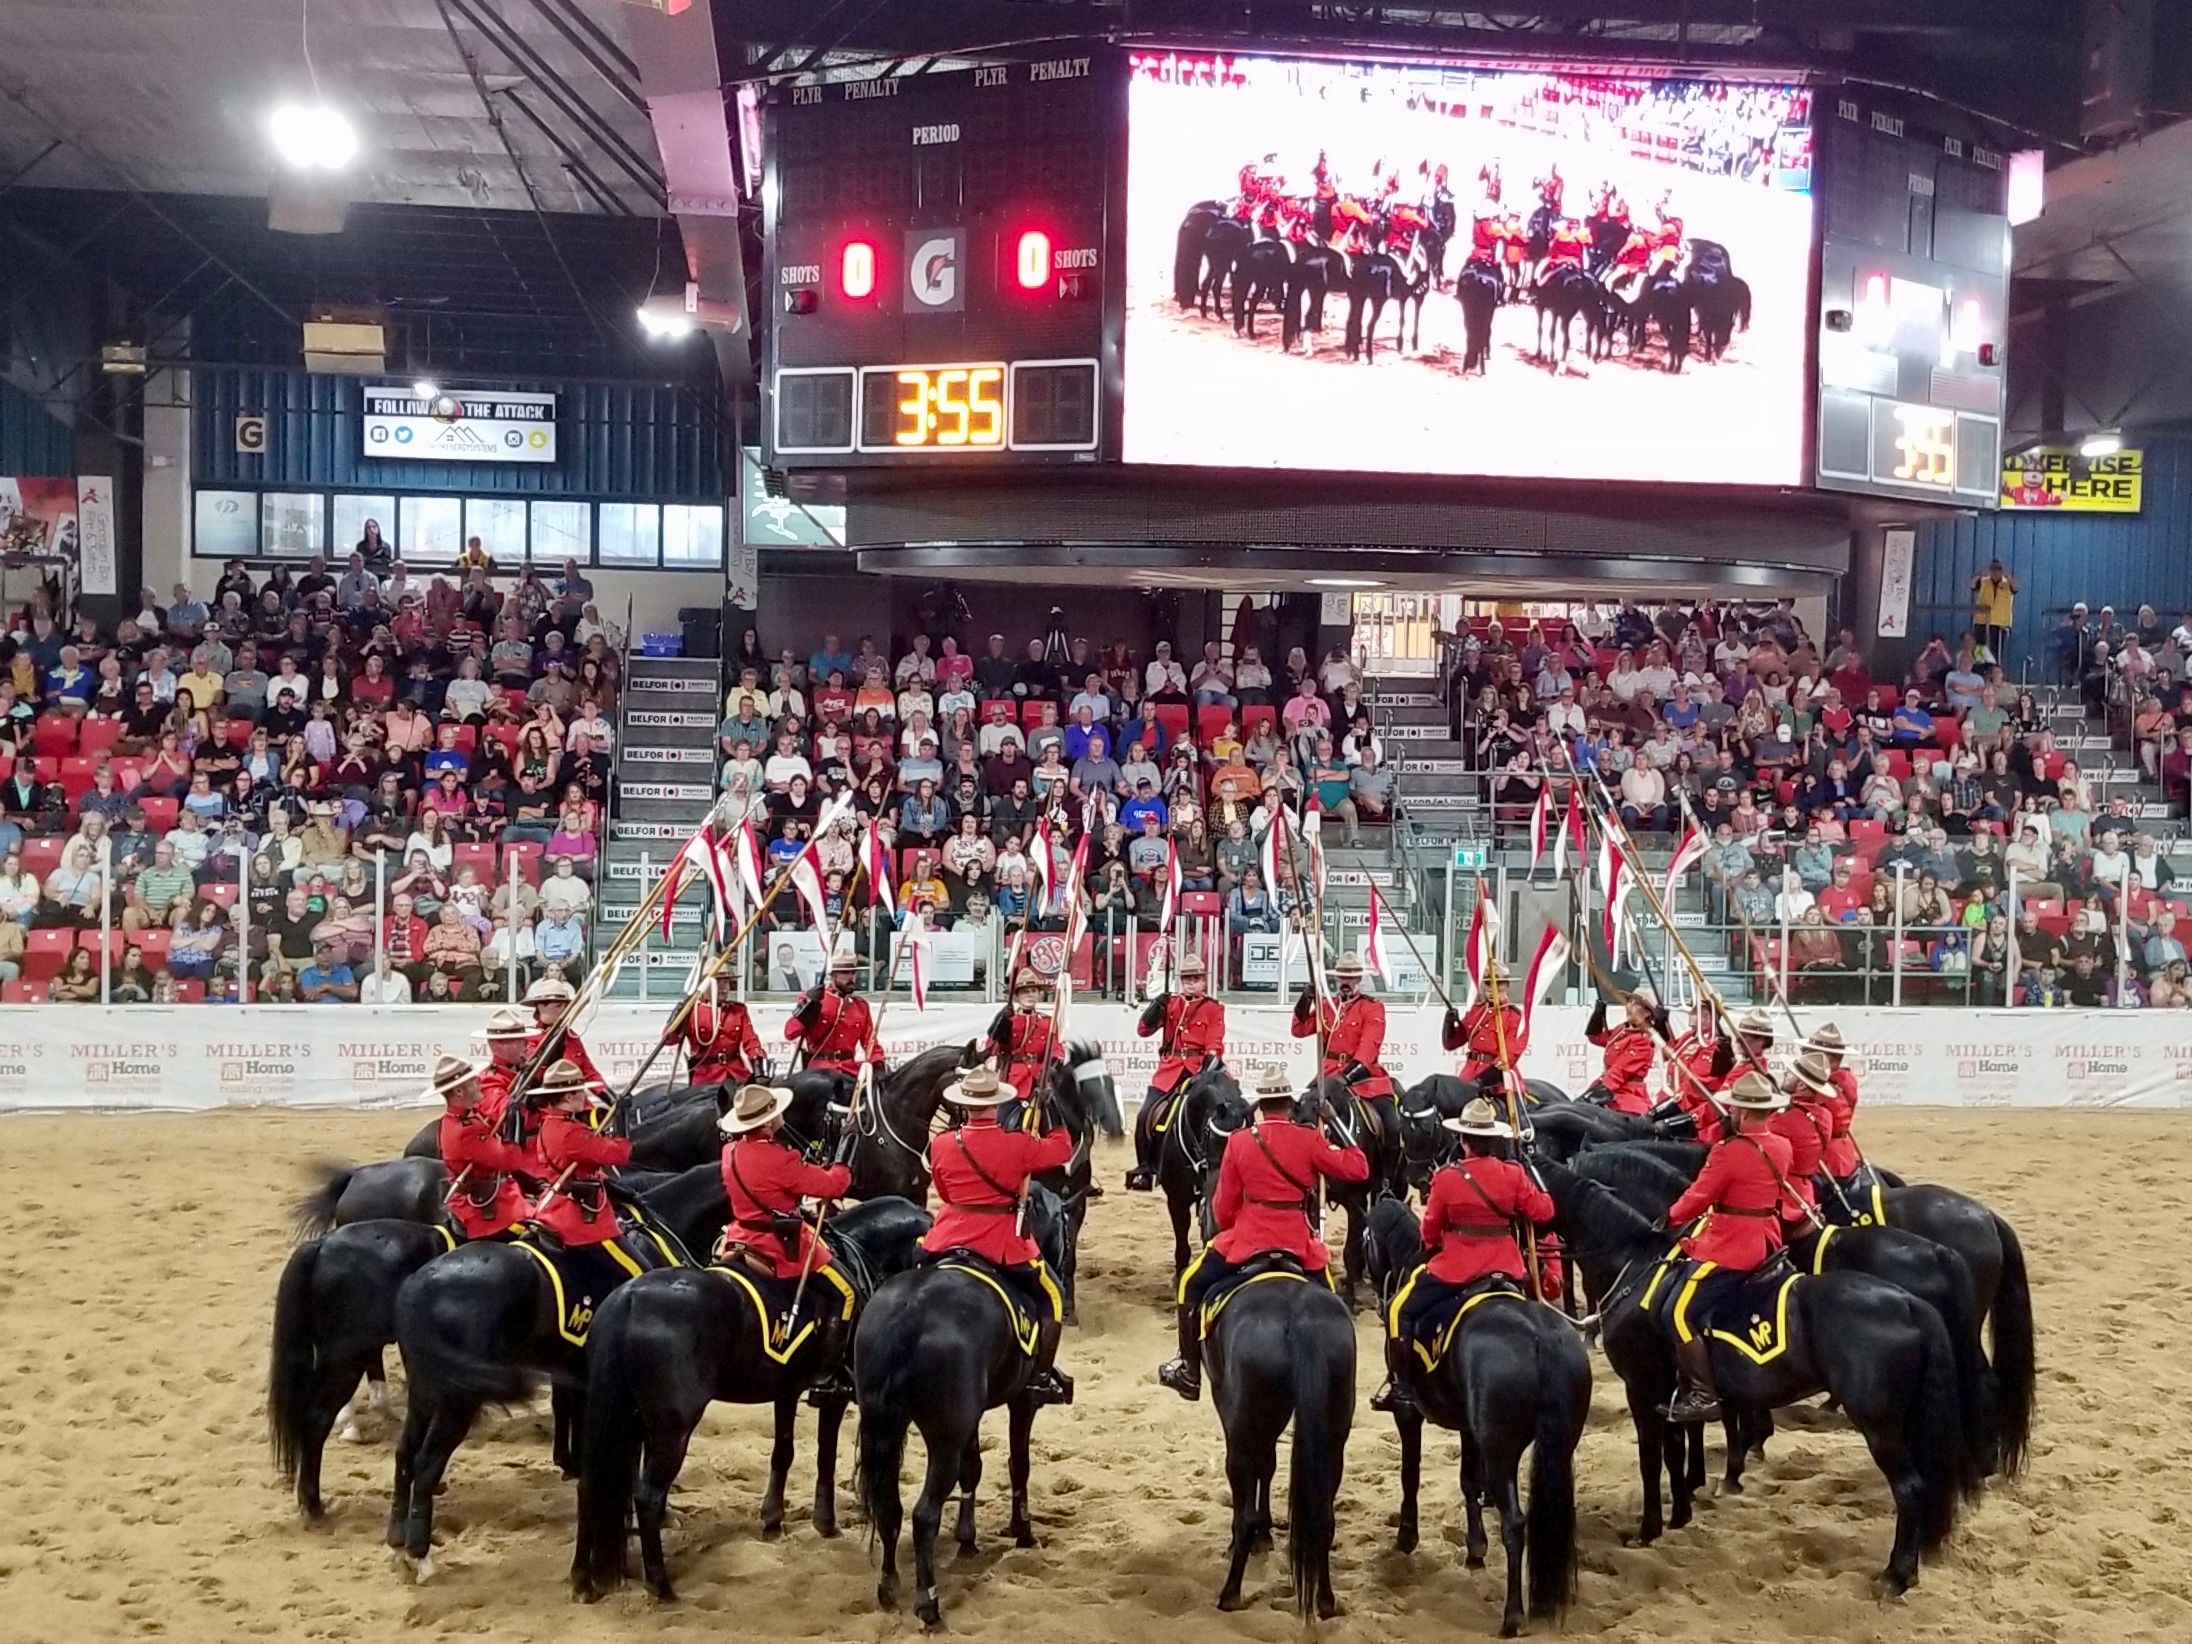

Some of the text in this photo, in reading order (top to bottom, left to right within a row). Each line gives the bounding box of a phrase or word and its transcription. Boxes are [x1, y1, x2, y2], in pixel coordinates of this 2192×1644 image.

[975, 67, 1007, 87] PLYR
[1030, 57, 1090, 82] PENALTY
[792, 85, 823, 105] PLYR
[844, 78, 900, 101] PENALTY
[912, 124, 960, 145] PERIOD
[1017, 231, 1050, 288] 0
[1054, 249, 1097, 269] SHOTS
[781, 266, 820, 284] SHOTS
[842, 243, 874, 298] 0
[910, 238, 955, 306] G
[465, 402, 491, 418] THE
[494, 404, 545, 420] ATTACK
[896, 369, 1001, 445] 3:55
[238, 421, 263, 449] G
[2046, 477, 2133, 499] HERE
[632, 680, 669, 689] BELFOR
[1361, 696, 1394, 704] BEFOR
[630, 714, 667, 724] BELFOR
[626, 750, 664, 759] BELFOR
[623, 786, 661, 796] BELFOR
[617, 826, 656, 836] BELFOR
[70, 1043, 178, 1058] MILLER'S
[205, 1043, 311, 1057] MILLER'S
[337, 1043, 443, 1057] MILLER'S
[1945, 1044, 2033, 1057] MILLER'S
[2054, 1045, 2142, 1058] MILLER'S
[111, 1060, 161, 1074] Home
[245, 1060, 295, 1074] Home
[378, 1060, 426, 1074] Home
[1245, 1058, 1289, 1071] Home
[1868, 1059, 1909, 1072] Home
[1978, 1059, 2019, 1073] Home
[2087, 1060, 2128, 1073] Home
[568, 1303, 593, 1330] MP
[770, 1318, 788, 1349] M
[1748, 1319, 1773, 1351] MP
